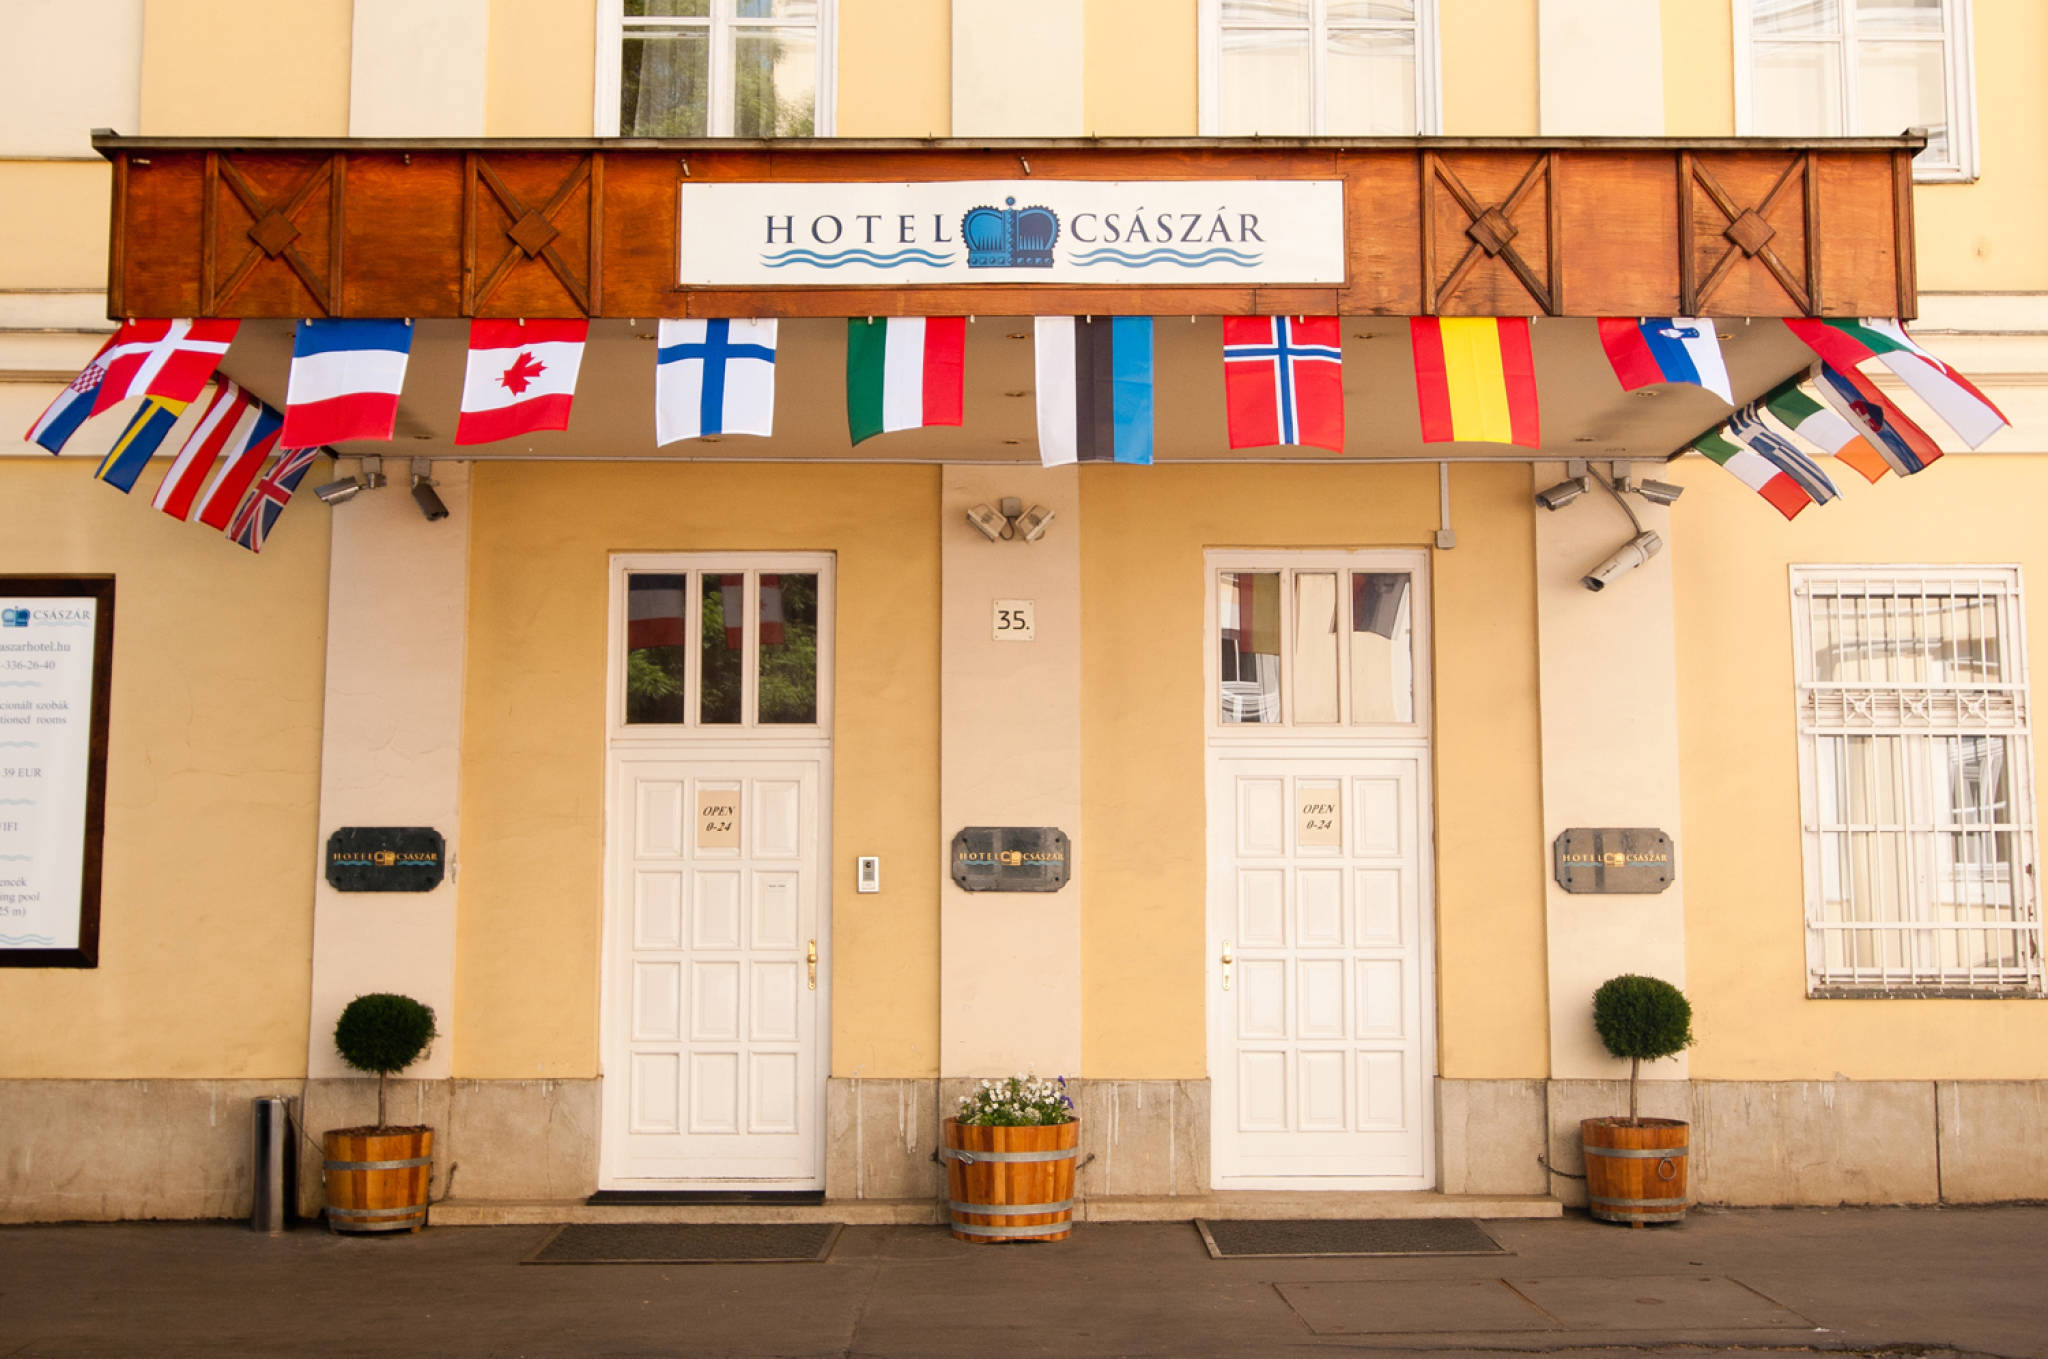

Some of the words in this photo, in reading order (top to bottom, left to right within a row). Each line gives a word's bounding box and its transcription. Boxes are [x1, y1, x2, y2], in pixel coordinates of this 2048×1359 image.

[763, 214, 953, 244] HOTEL
[1070, 205, 1266, 243] CSÁSZÁR
[997, 610, 1031, 630] 35.
[37, 717, 68, 725] rooms
[18, 767, 42, 777] EUR
[702, 806, 736, 817] OPEN
[1303, 804, 1336, 815] OPEN
[705, 821, 733, 832] 0-24
[1306, 819, 1333, 830] 0-24
[333, 852, 373, 861] HOTEL
[959, 852, 999, 861] HOTEL
[1562, 853, 1602, 862] HOTEL
[18, 891, 41, 904] pool
